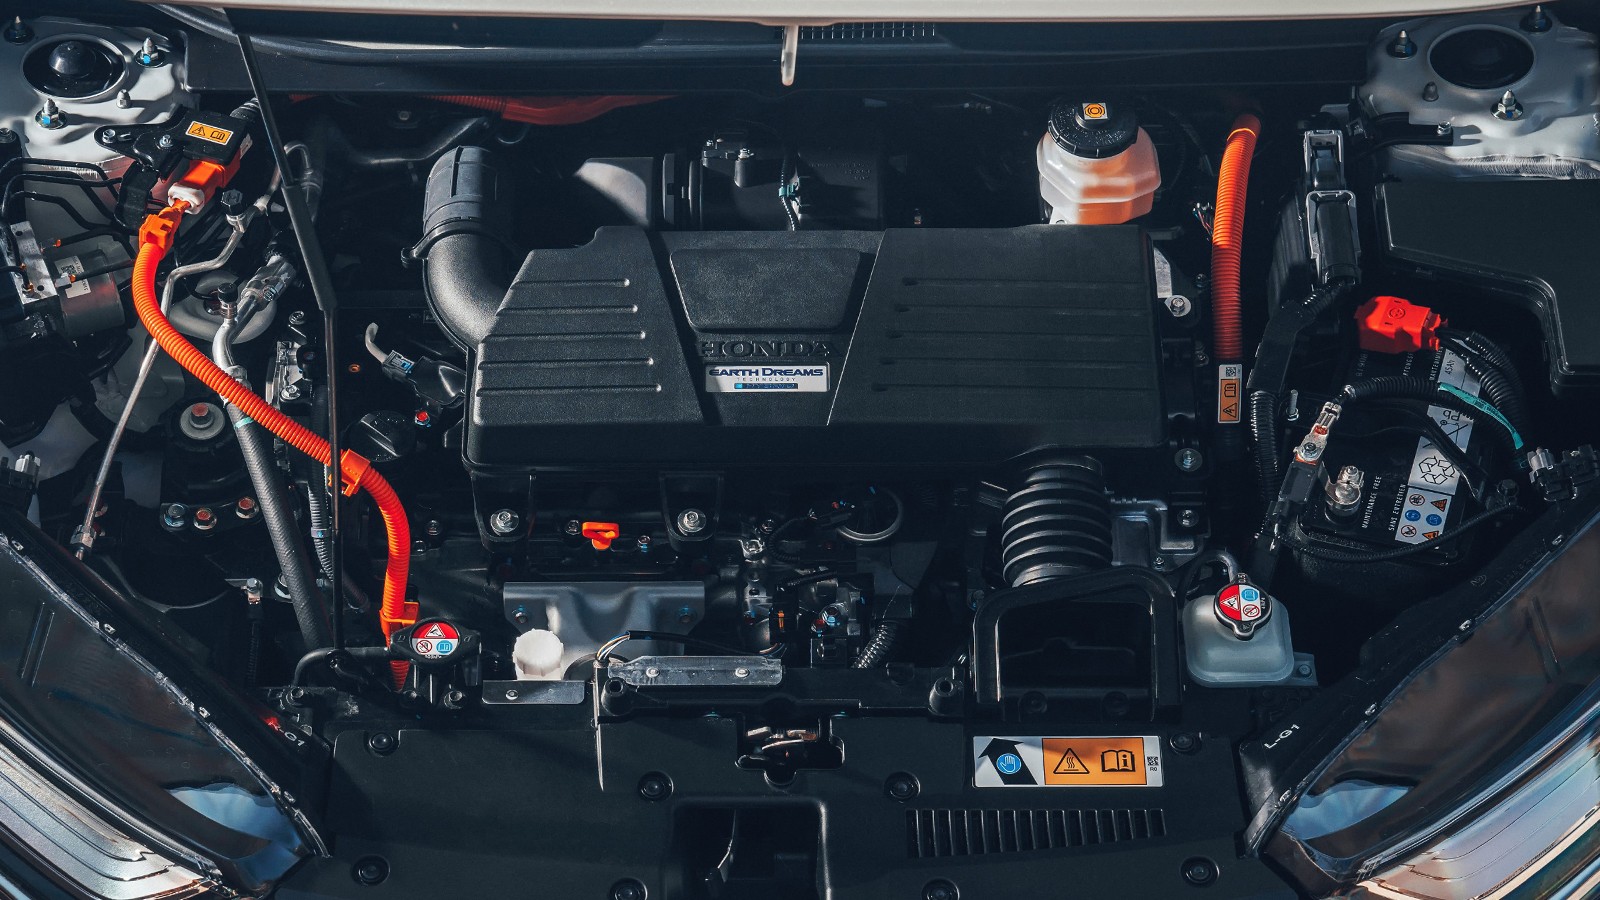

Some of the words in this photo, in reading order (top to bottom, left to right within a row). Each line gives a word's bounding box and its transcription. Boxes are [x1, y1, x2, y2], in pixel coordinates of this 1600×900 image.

[702, 340, 836, 357] HONDA
[709, 368, 759, 377] EARTH
[761, 367, 824, 377] DREAMS
[1429, 346, 1444, 381] MANTENIMIEN
[1445, 359, 1456, 375] 45Ah
[1443, 409, 1461, 421] Pb
[1361, 492, 1378, 529] MAINTENANCE
[1373, 476, 1381, 490] FREE
[1392, 484, 1406, 515] ENTRETIEN
[1388, 517, 1398, 531] SANS
[1263, 723, 1300, 749] L-G1
